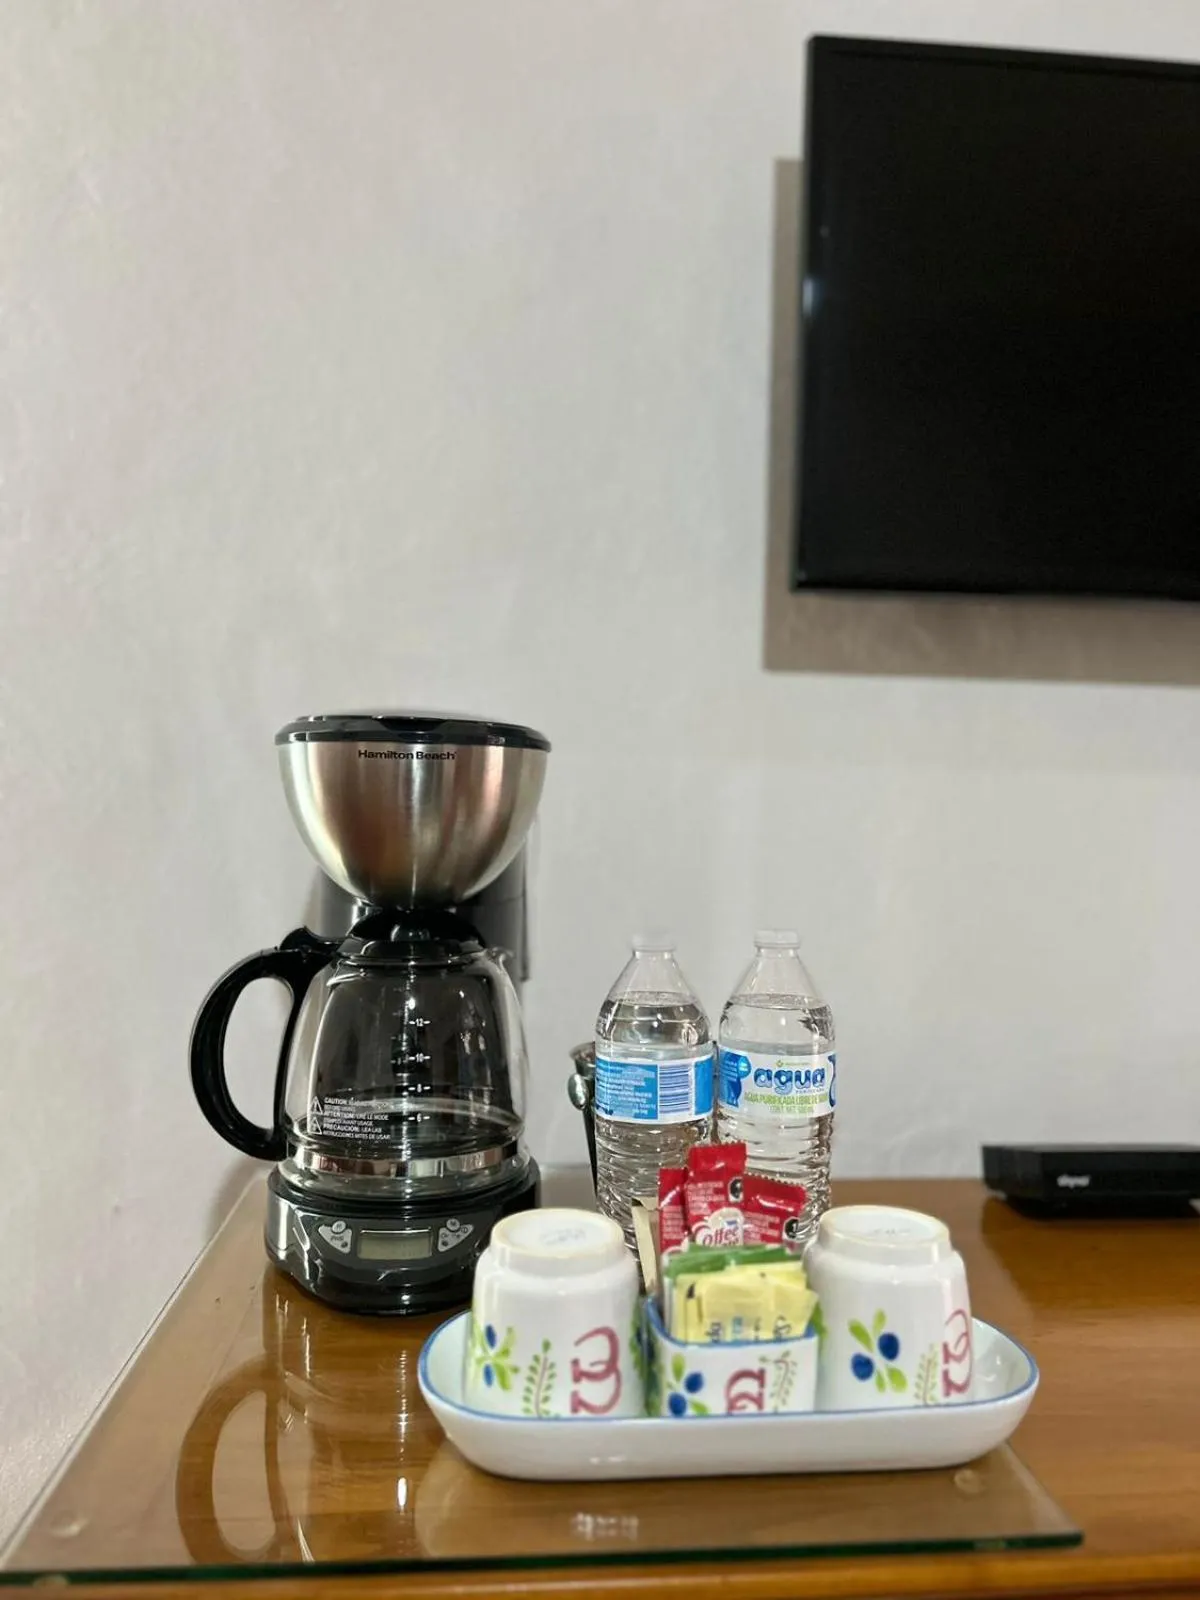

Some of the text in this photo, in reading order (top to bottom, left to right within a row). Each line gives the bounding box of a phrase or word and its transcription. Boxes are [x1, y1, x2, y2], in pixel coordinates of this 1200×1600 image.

[358, 749, 455, 760] Hamilton Beach
[416, 1018, 424, 1027] 12
[754, 1068, 825, 1095] agua
